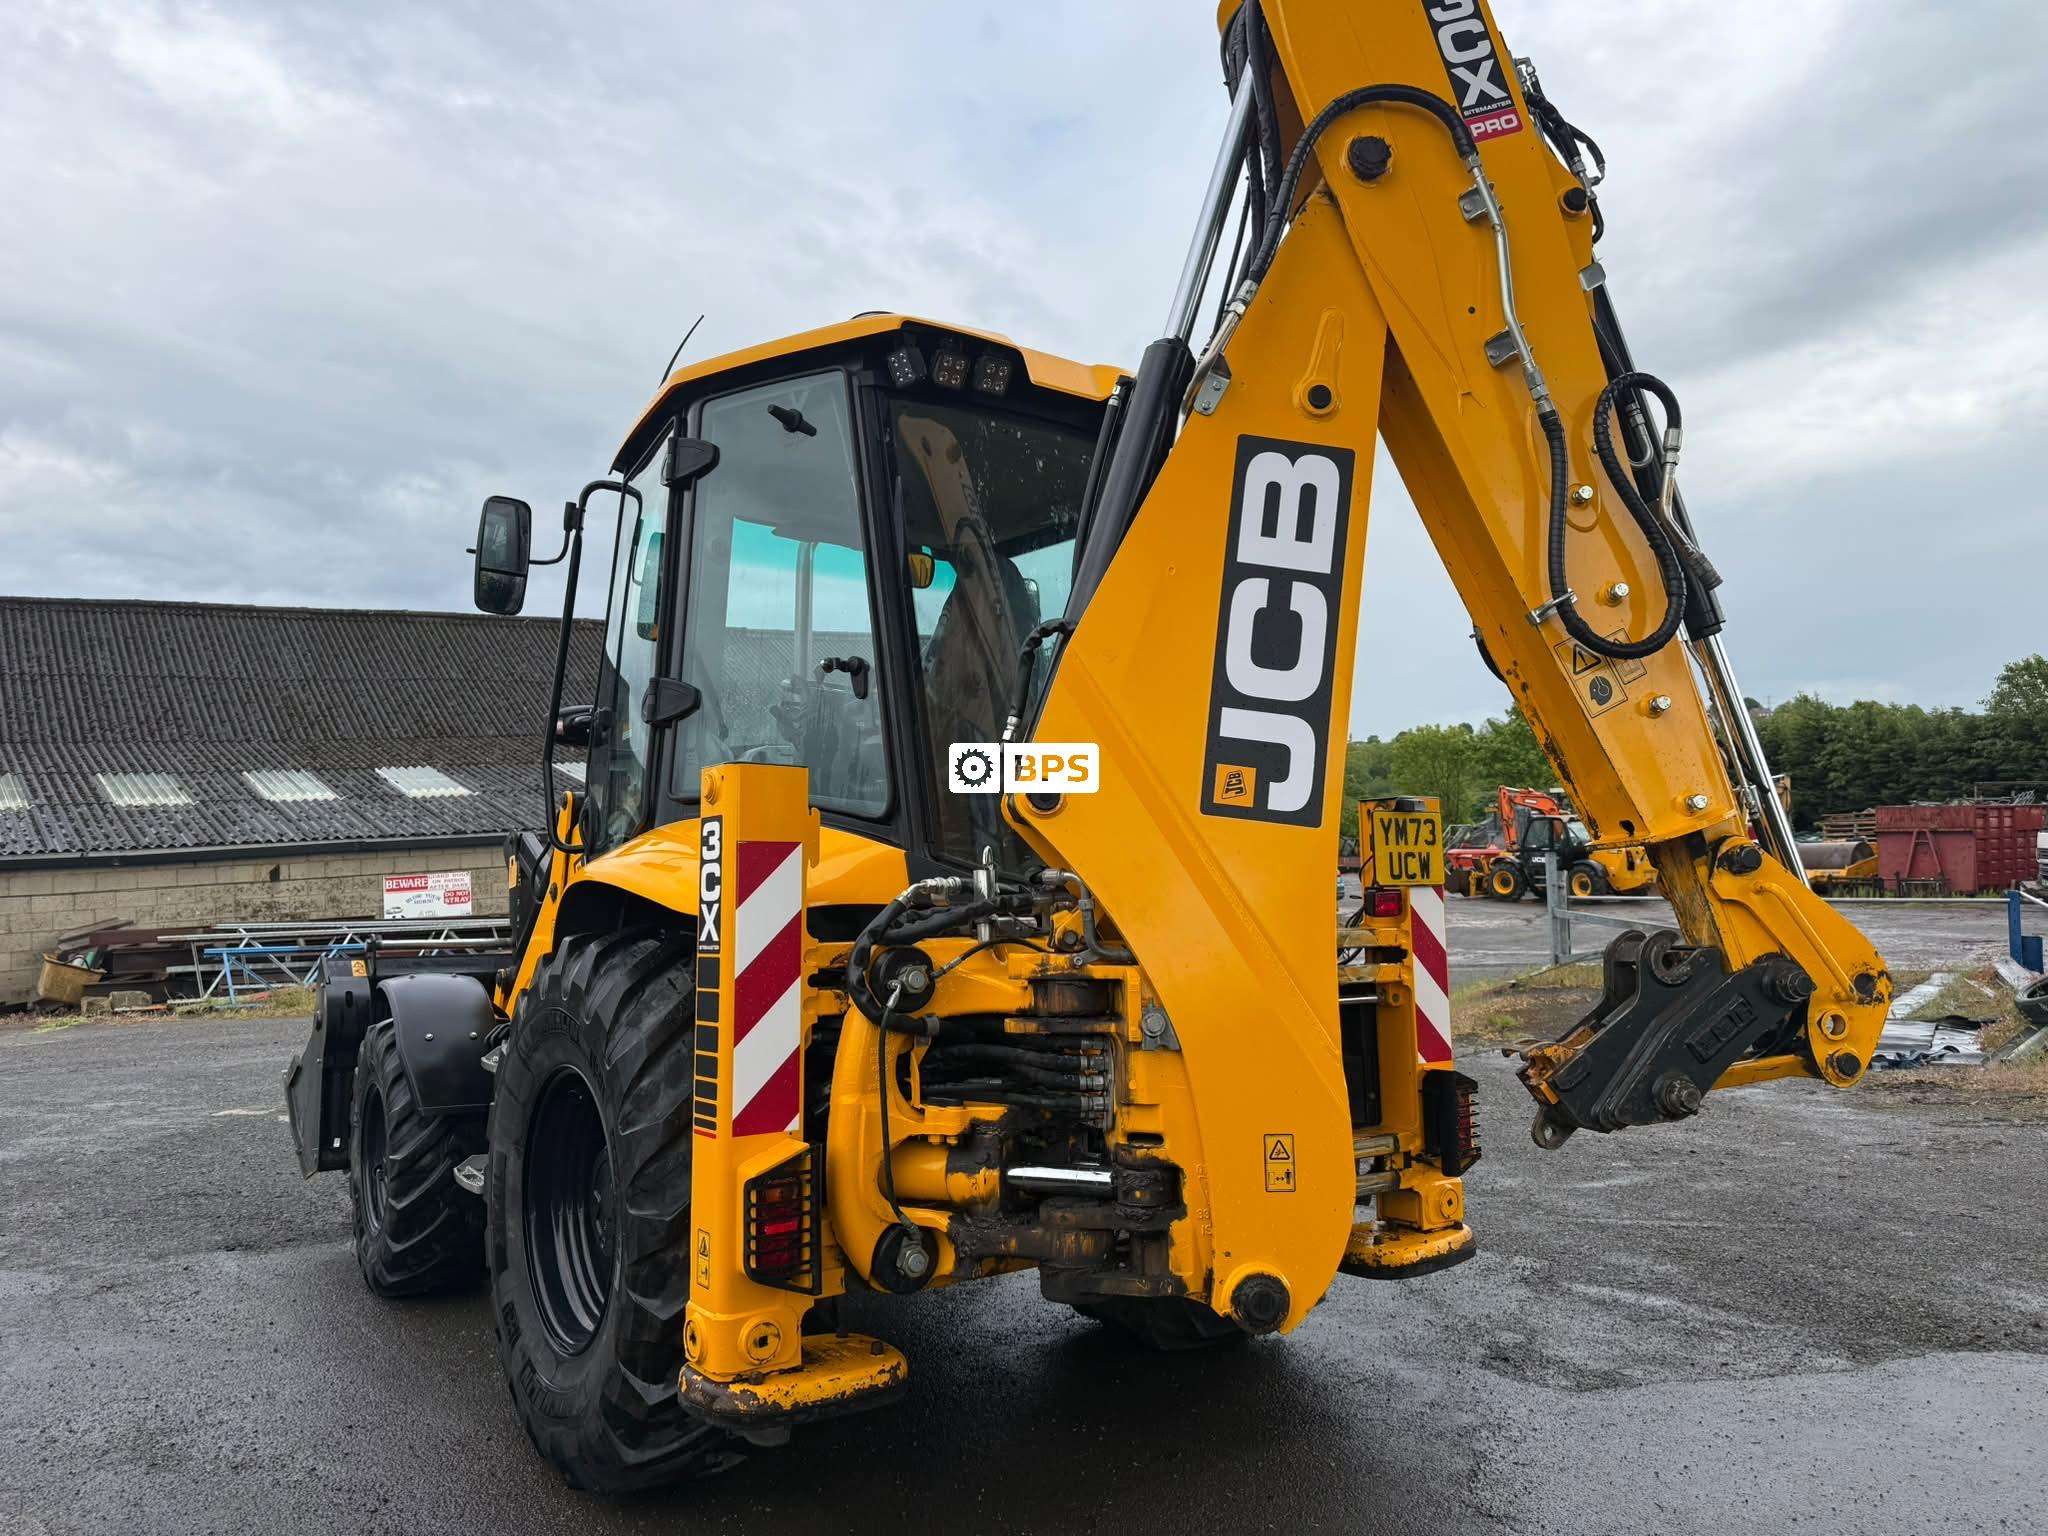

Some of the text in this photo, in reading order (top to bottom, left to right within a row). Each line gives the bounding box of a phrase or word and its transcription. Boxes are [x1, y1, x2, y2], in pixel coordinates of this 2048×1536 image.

[1464, 100, 1512, 117] SITEMASTER
[1470, 113, 1519, 137] PRO
[1219, 451, 1341, 812] JCB
[1379, 817, 1436, 846] YM73
[1388, 851, 1431, 880] UCW
[385, 878, 428, 890] BEWARE
[699, 821, 720, 941] 3CX
[445, 895, 469, 904] STRAY
